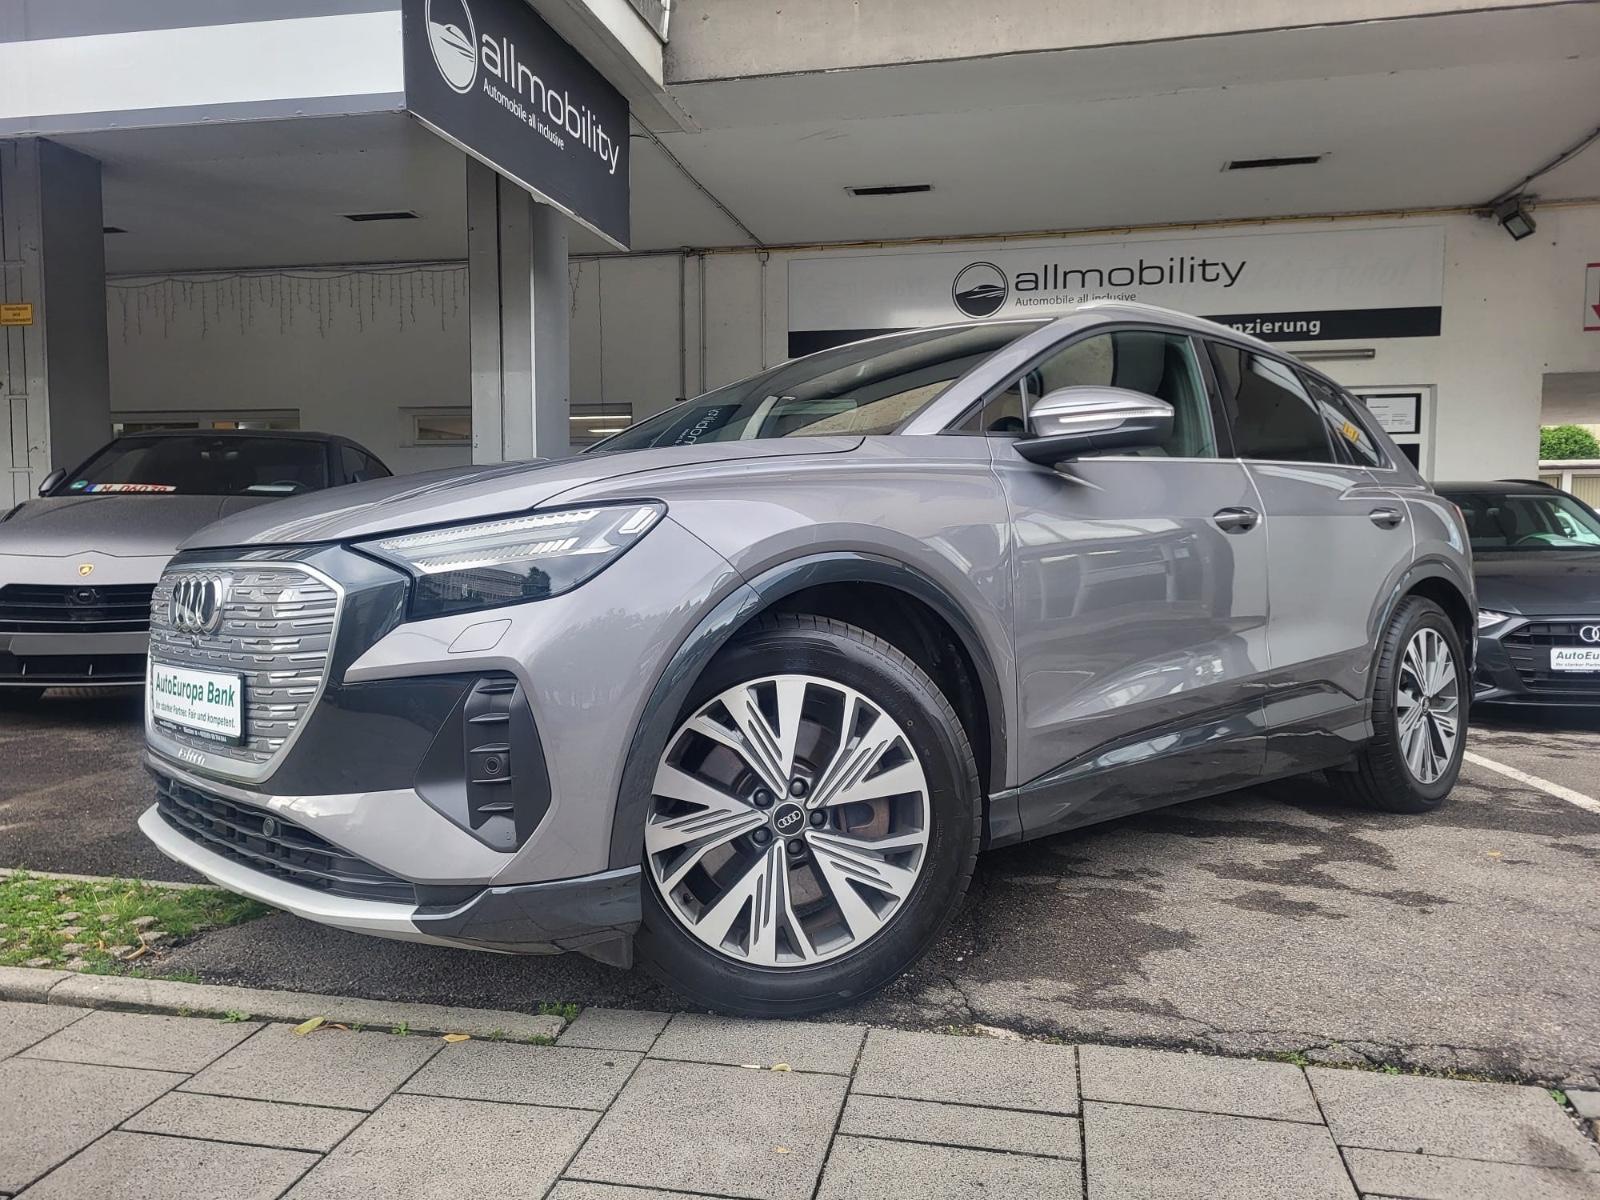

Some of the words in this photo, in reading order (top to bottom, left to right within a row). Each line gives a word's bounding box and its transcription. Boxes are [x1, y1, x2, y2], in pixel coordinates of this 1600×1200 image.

[481, 33, 619, 174] allmobility
[483, 77, 527, 122] Automobile
[528, 113, 536, 130] all
[537, 118, 565, 151] inclusive
[1015, 256, 1247, 291] allmobility
[1015, 295, 1074, 306] Automobile
[1077, 294, 1088, 303] all
[156, 672, 204, 706] AutoEuropa
[207, 681, 235, 707] Bank
